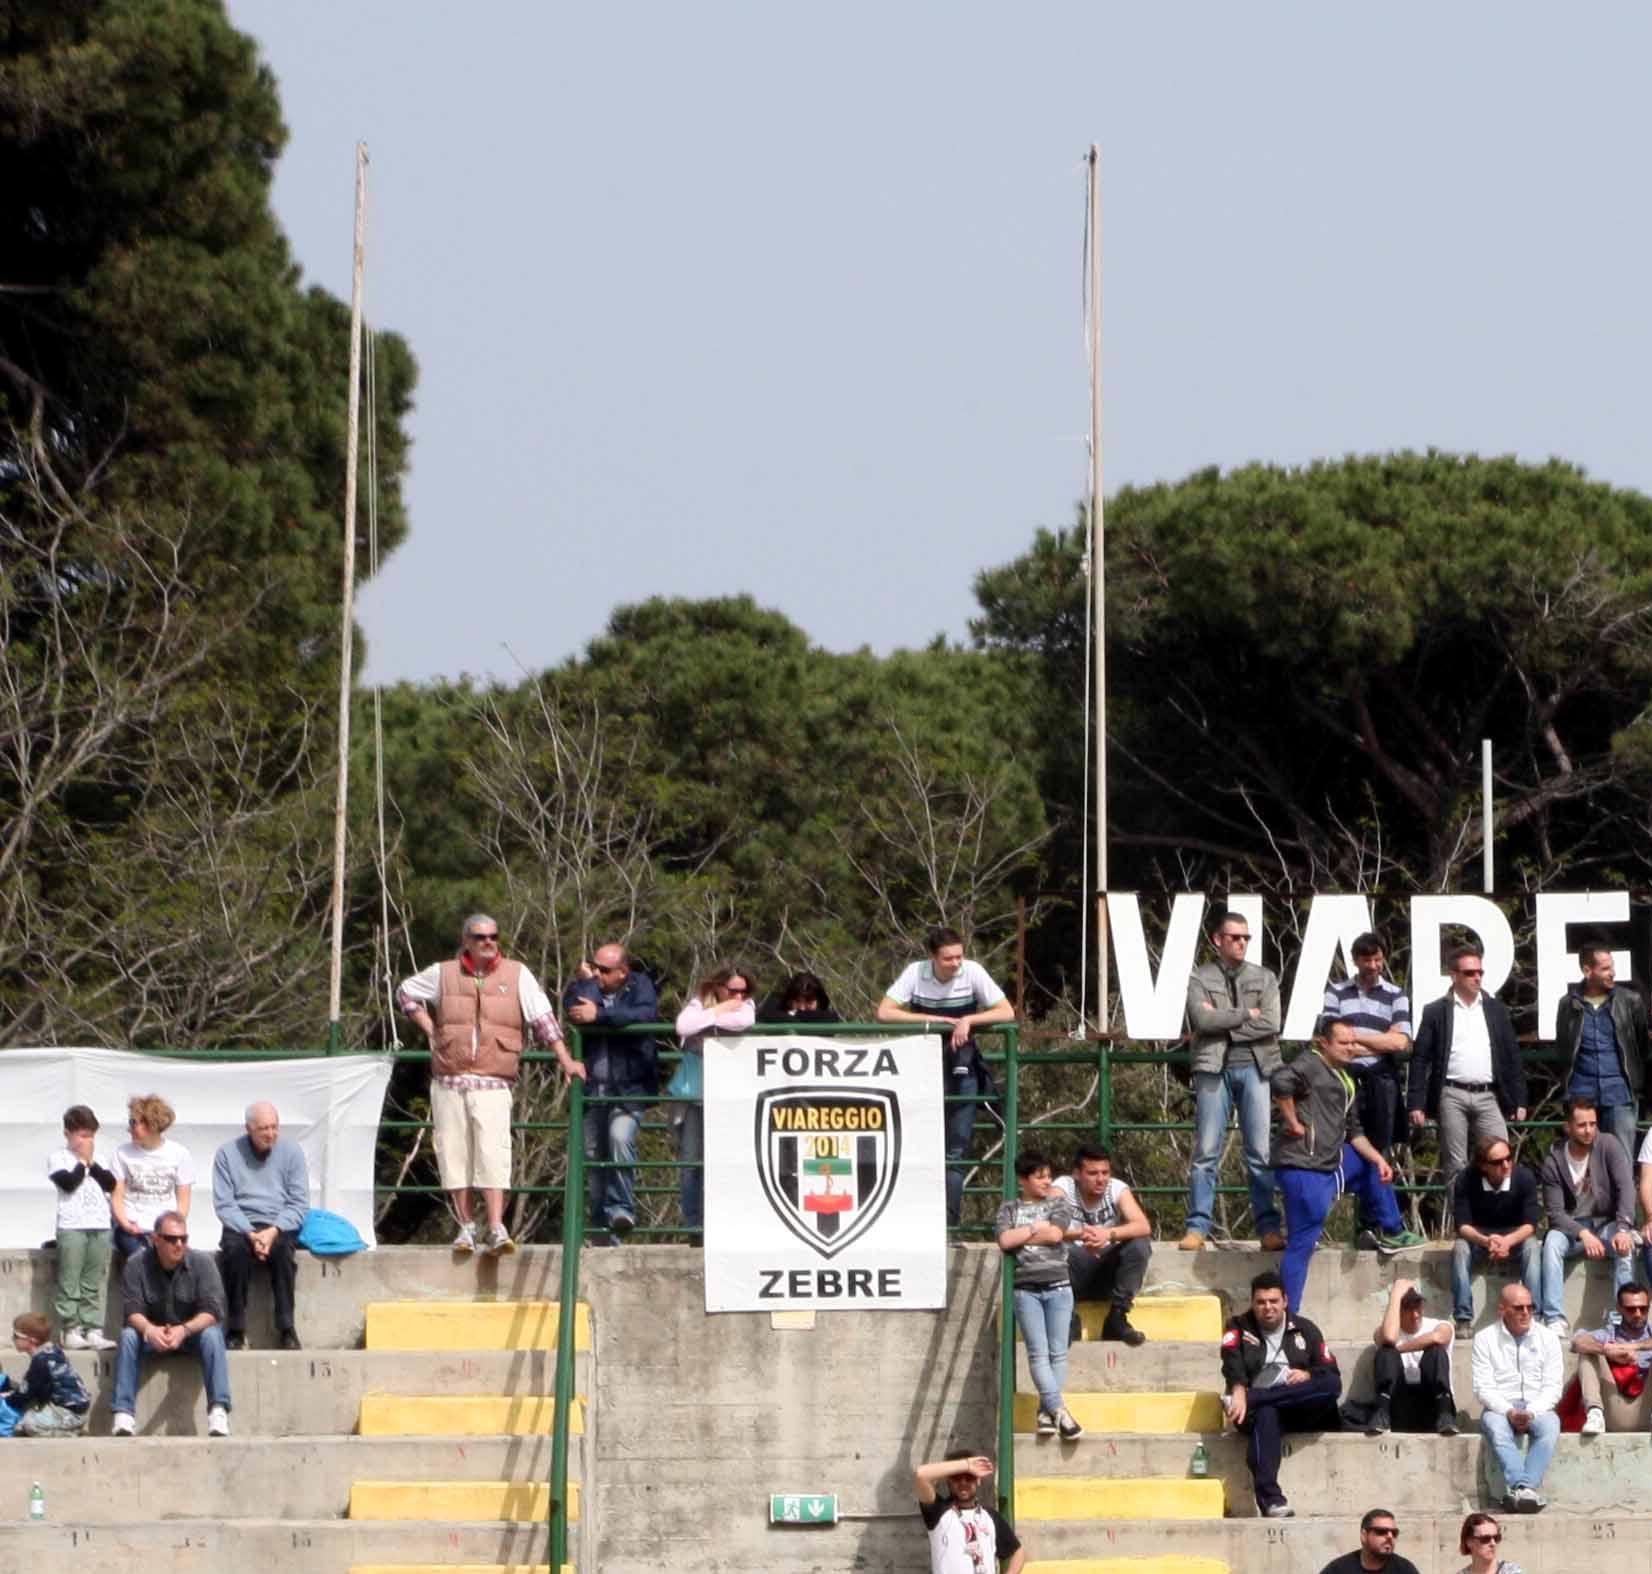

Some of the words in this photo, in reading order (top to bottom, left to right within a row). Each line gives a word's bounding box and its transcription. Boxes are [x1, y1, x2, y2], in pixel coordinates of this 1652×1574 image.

[756, 1048, 899, 1077] FORZA
[772, 1106, 883, 1130] VIAREGGIO
[805, 1135, 850, 1157] 2014
[758, 1268, 902, 1298] ZEBRE
